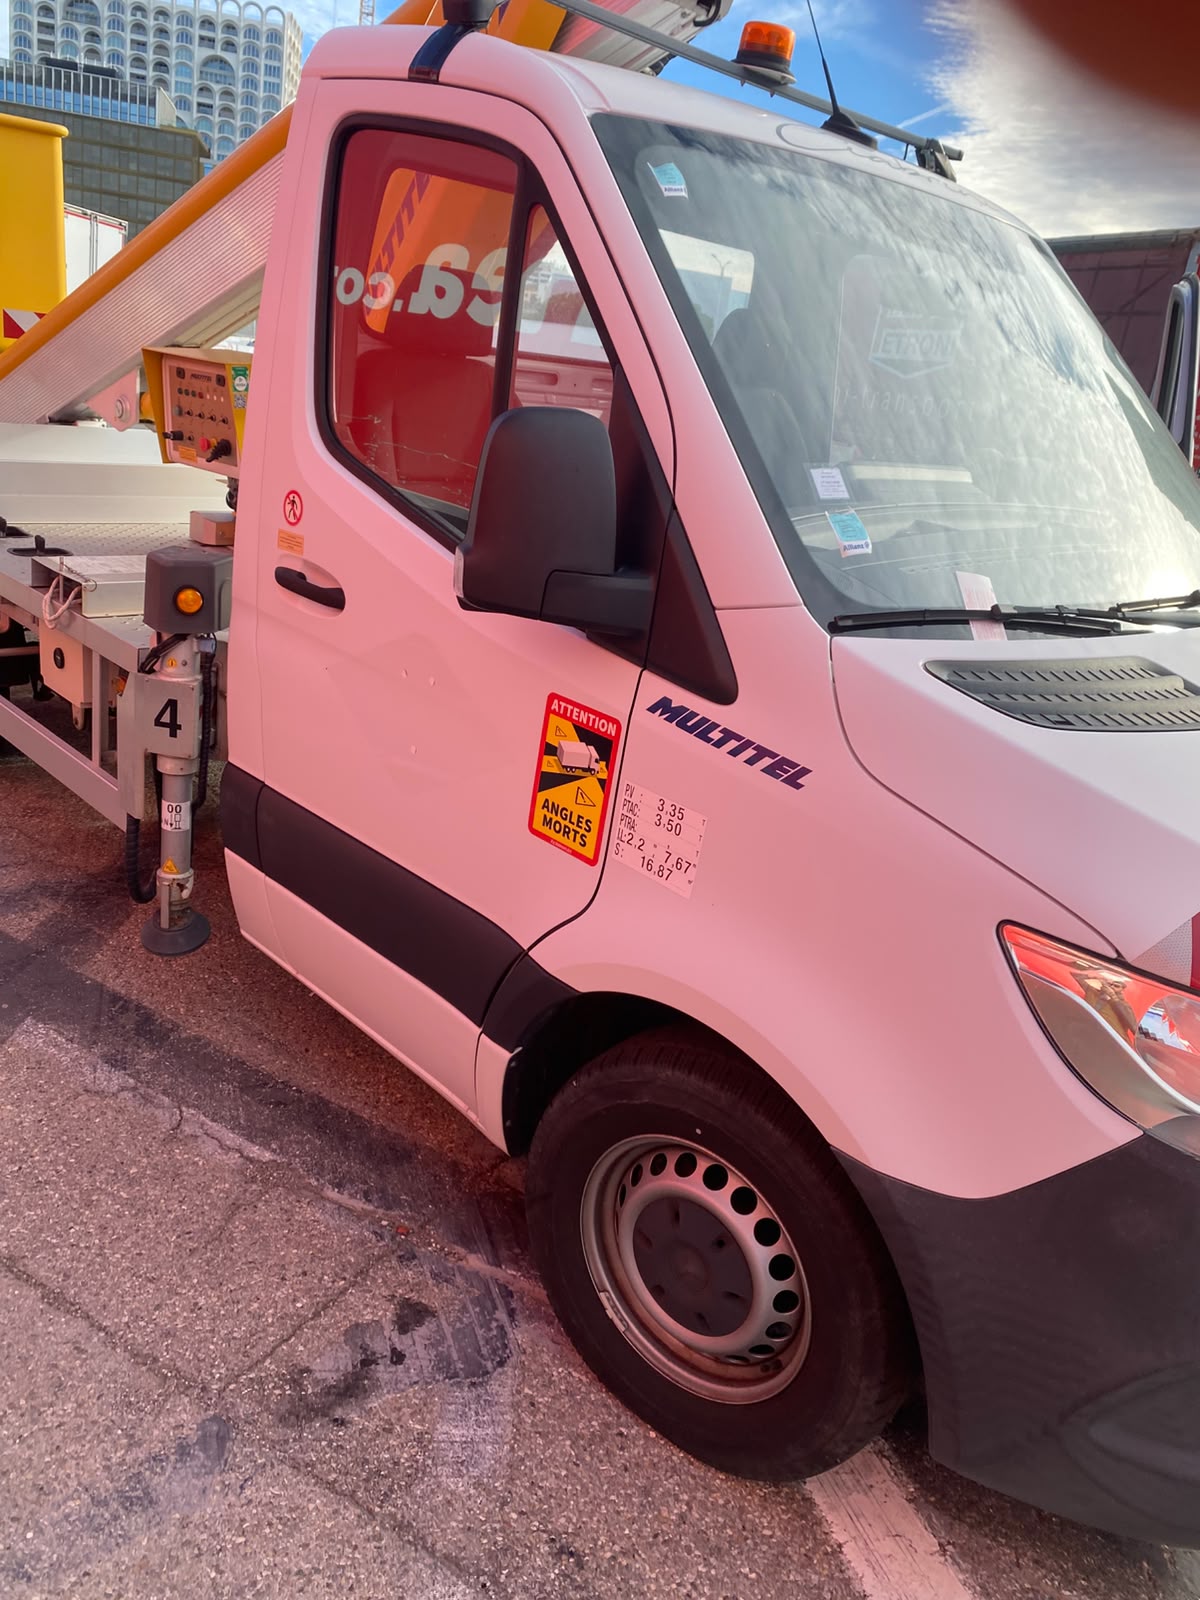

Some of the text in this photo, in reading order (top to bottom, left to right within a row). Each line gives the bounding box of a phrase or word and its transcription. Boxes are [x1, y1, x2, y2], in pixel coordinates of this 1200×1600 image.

[843, 543, 865, 552] Allianz
[154, 698, 182, 738] 4
[551, 699, 617, 737] ATTENTION
[646, 696, 813, 791] MULTITEL
[541, 798, 592, 833] ANGLES
[658, 798, 685, 821] 3,35
[542, 814, 587, 848] MORTS
[655, 814, 682, 836] 3,50
[640, 855, 673, 881] 16,87
[664, 850, 692, 874] 7,67
